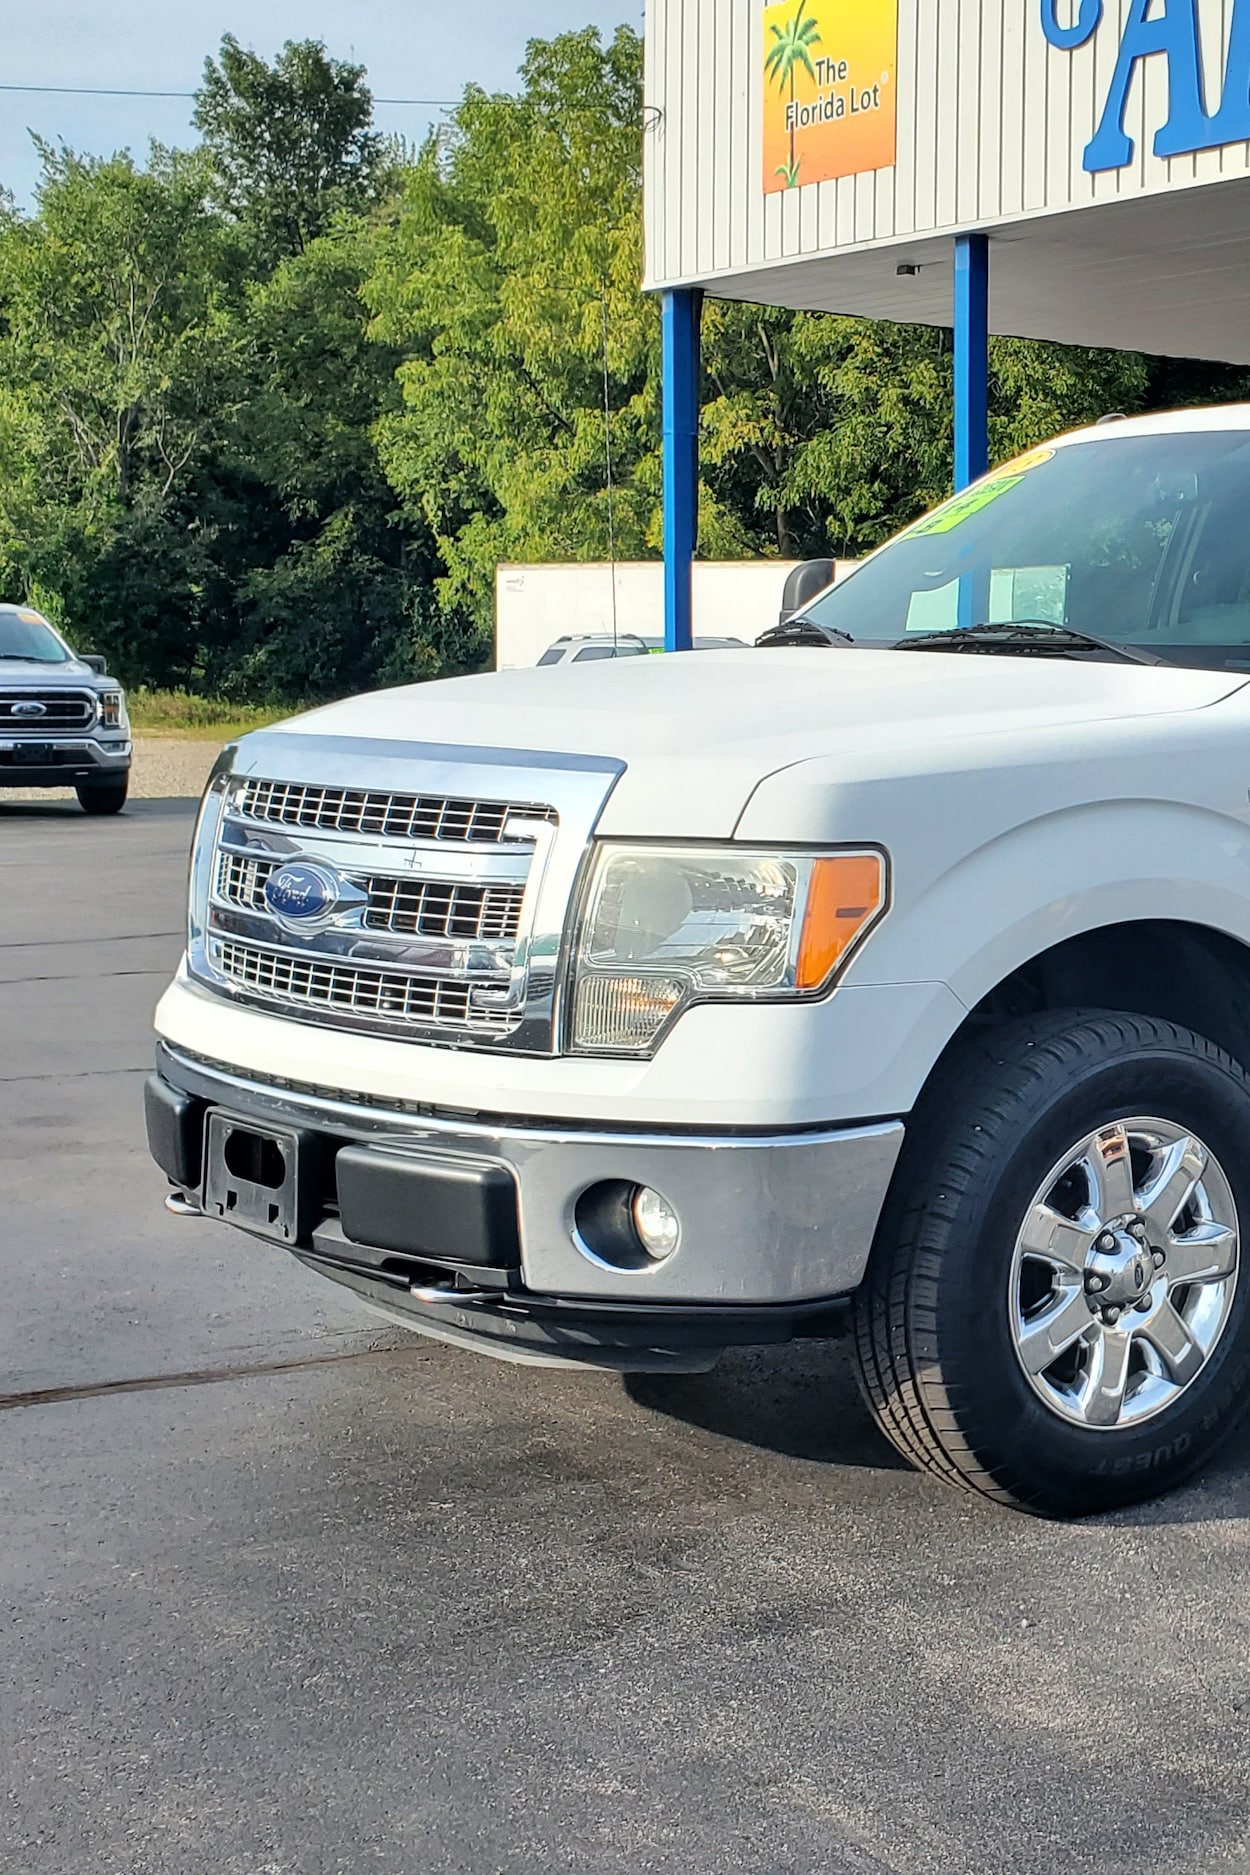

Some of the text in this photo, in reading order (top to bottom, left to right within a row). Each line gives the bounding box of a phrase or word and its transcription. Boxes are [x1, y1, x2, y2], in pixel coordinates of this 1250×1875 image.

[815, 57, 847, 86] The
[785, 84, 879, 131] Florida Lot
[272, 872, 313, 907] Ford
